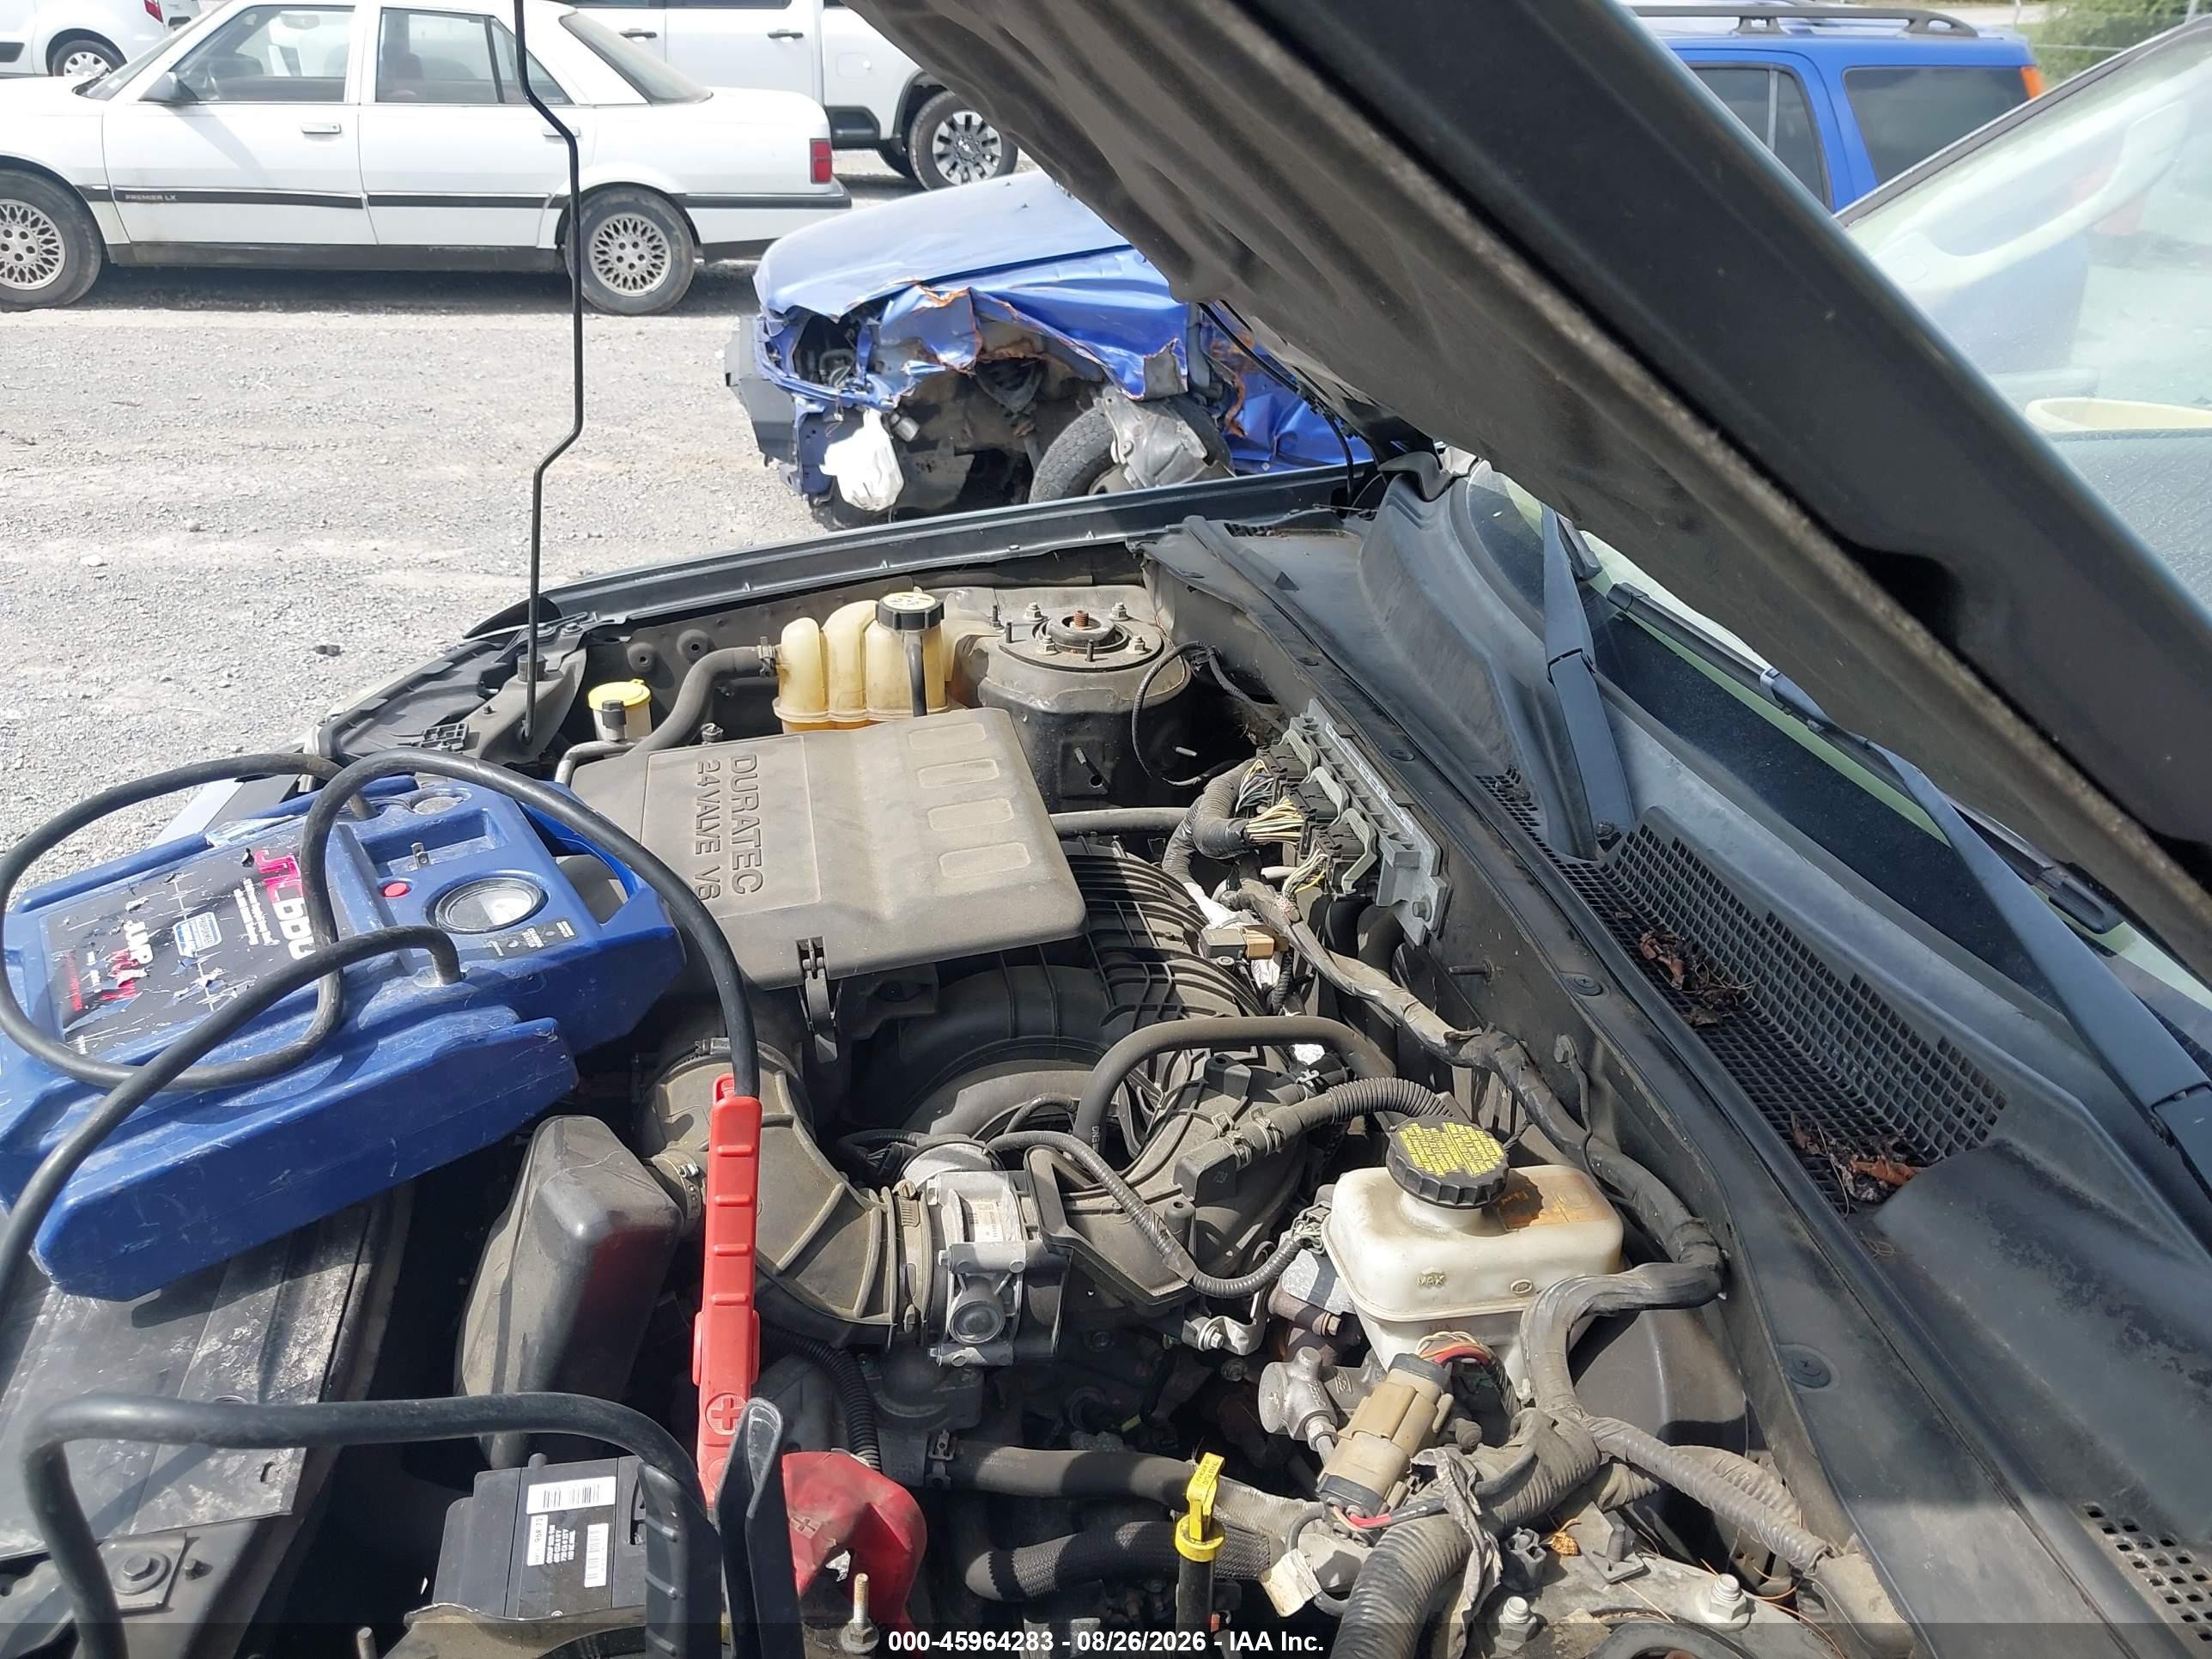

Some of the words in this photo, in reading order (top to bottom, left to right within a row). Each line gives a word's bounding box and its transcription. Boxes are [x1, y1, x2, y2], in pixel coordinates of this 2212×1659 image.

[697, 759, 721, 787] 24
[696, 788, 721, 855] VALVE
[730, 754, 763, 895] DURATEC
[694, 865, 721, 901] V6
[124, 921, 153, 963] JUMP
[1091, 1124, 1101, 1145] ENG
[1416, 1273, 1446, 1288] MAX
